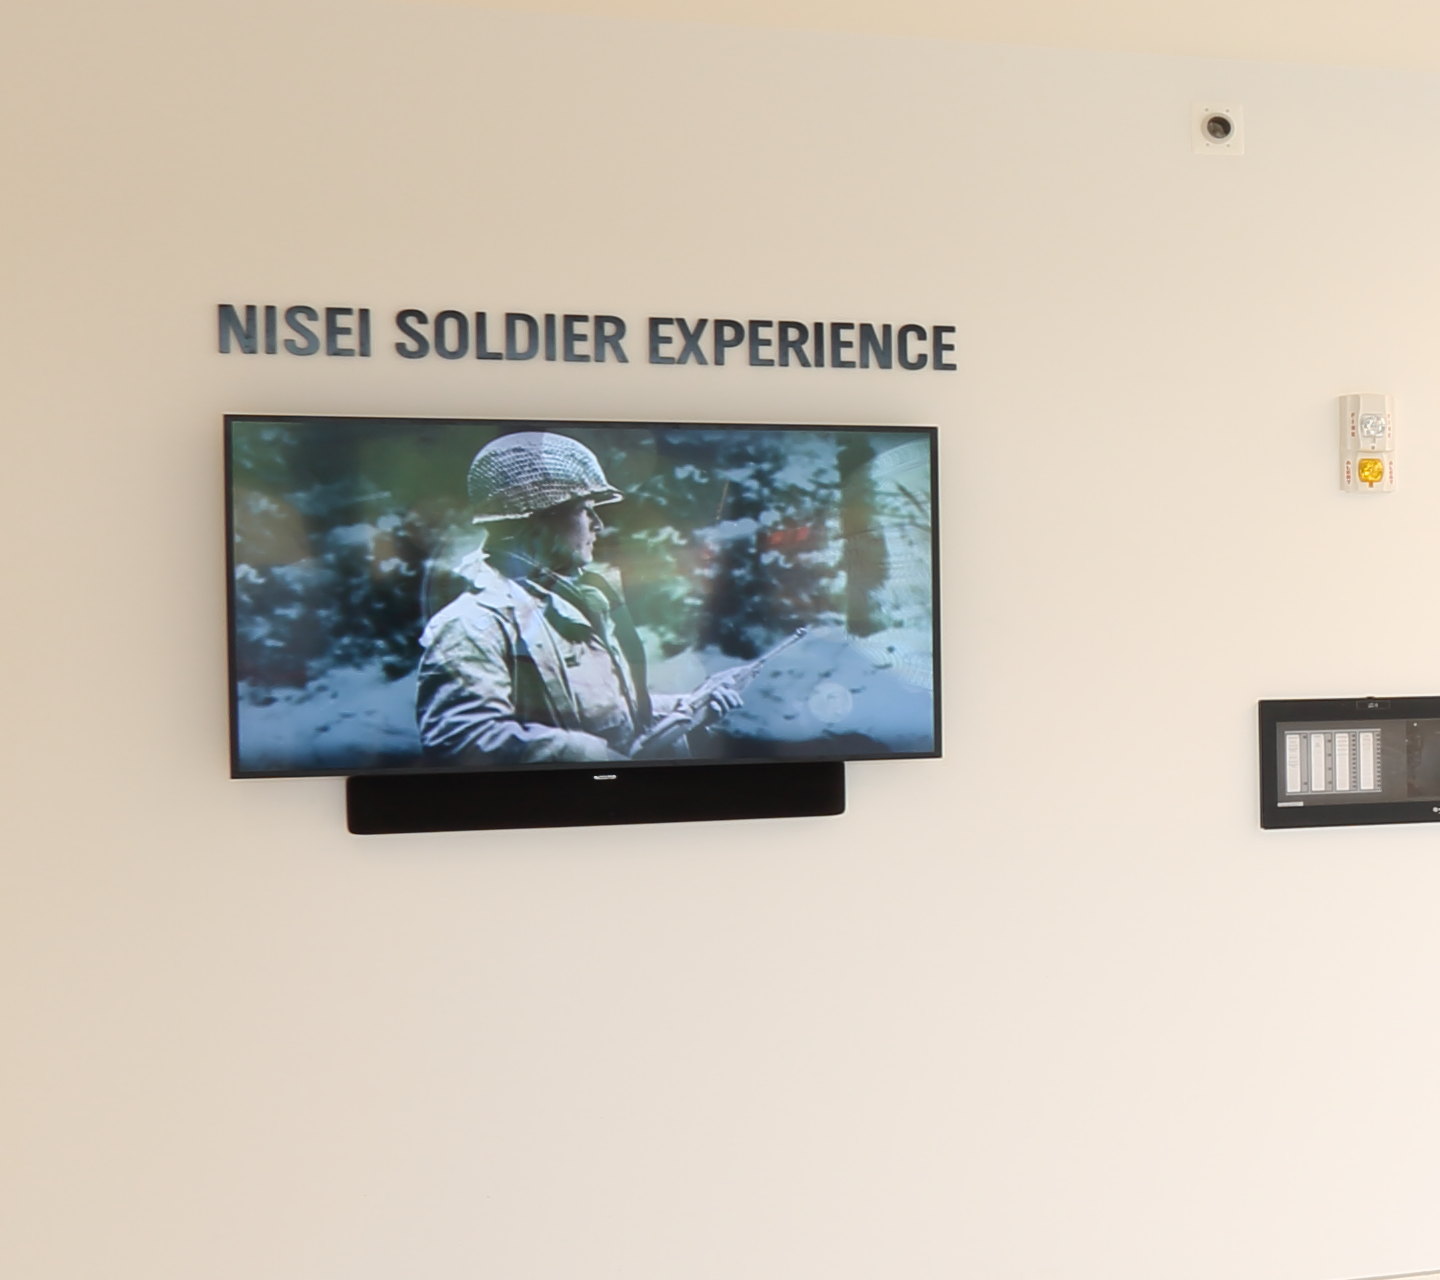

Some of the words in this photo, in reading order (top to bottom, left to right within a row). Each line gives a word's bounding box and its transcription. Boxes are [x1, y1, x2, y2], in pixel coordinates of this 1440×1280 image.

[217, 304, 371, 357] NISEI
[395, 309, 629, 363] SOLDIER
[648, 317, 957, 371] EXPERIENCE
